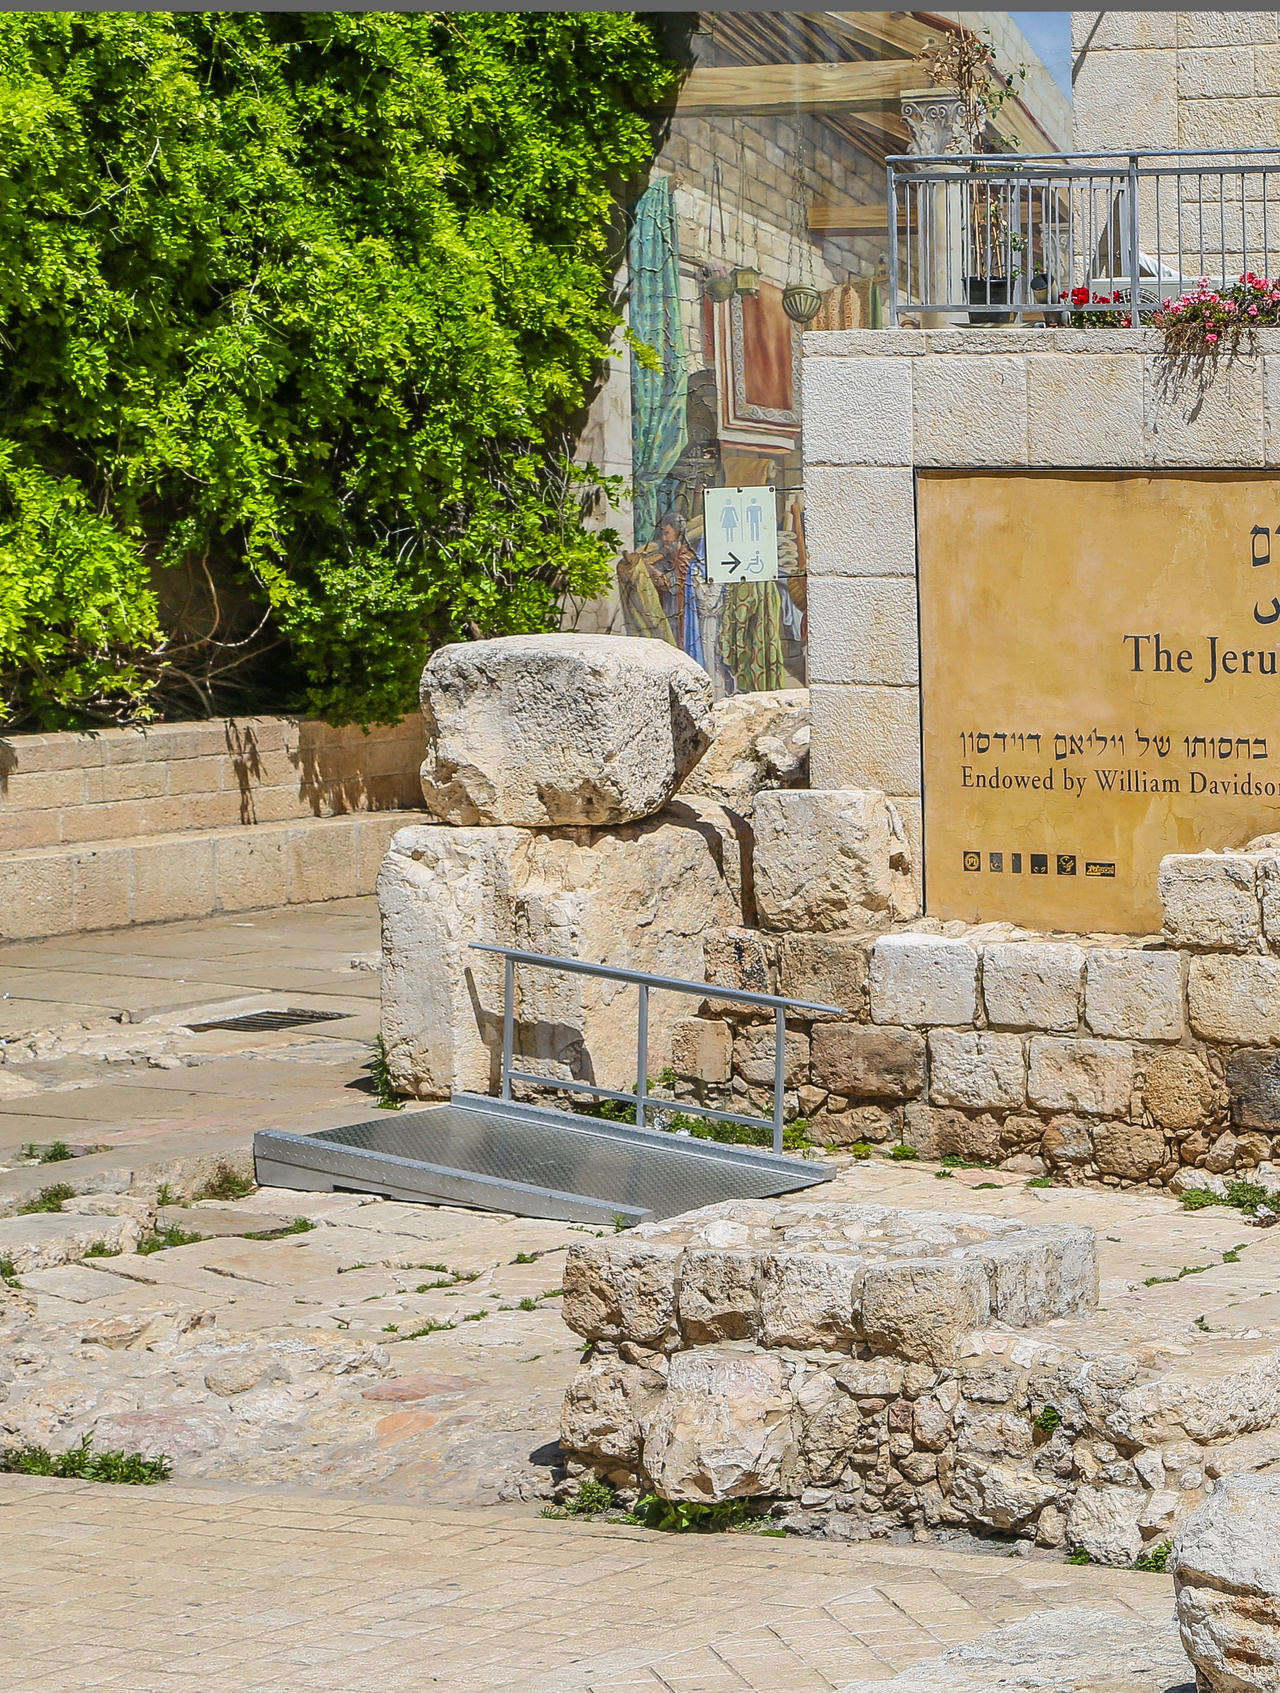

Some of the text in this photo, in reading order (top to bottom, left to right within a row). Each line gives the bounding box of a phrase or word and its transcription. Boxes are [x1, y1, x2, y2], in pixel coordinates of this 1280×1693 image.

[1123, 633, 1193, 673] The
[959, 727, 1268, 761] בחסותו של ויליאם דוידסון
[961, 765, 1054, 790] Endowed
[1063, 767, 1088, 800] by
[1094, 769, 1180, 793] William
